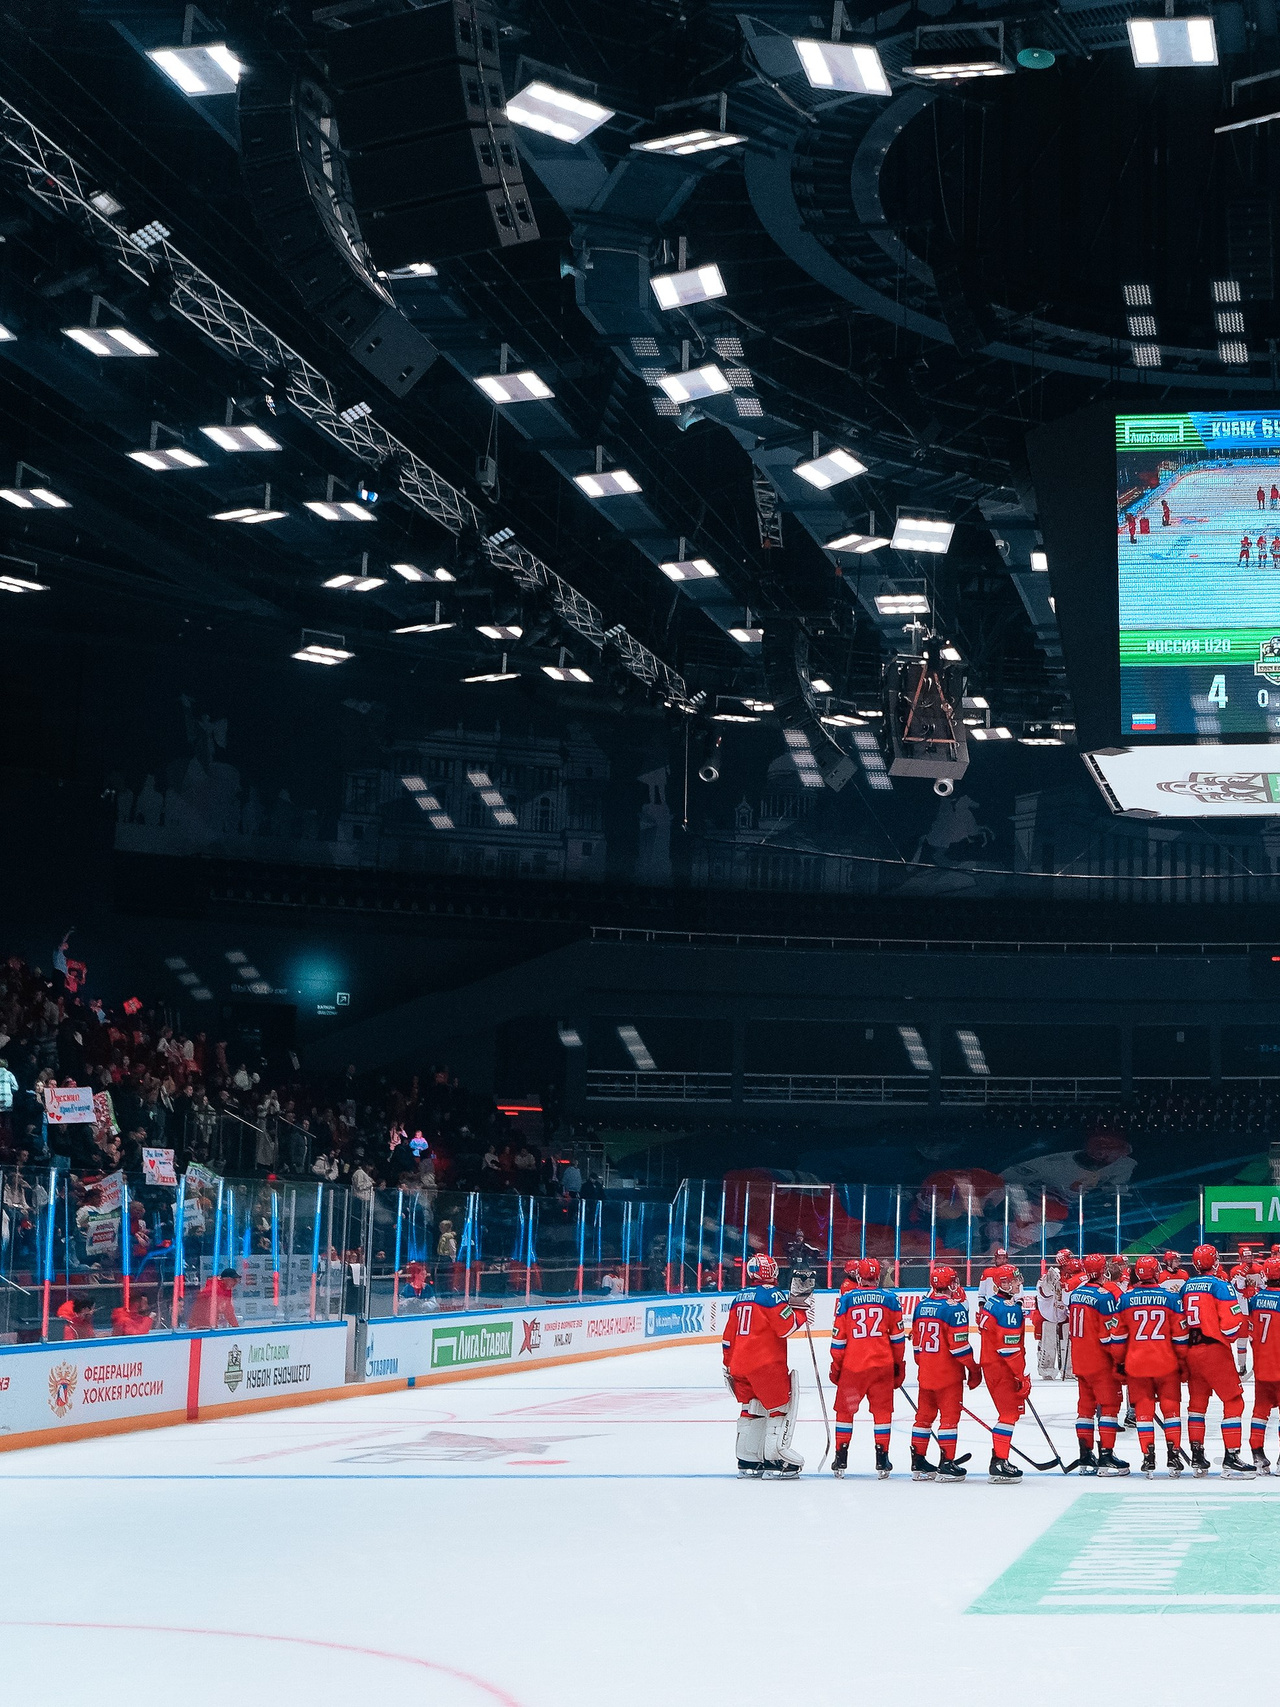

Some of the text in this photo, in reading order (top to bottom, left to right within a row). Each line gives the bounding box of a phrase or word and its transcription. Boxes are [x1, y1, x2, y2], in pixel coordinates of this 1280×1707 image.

[1146, 638, 1231, 654] РОССИЯ U20
[1207, 674, 1229, 709] 4
[852, 1295, 885, 1305] KHVOROV
[1129, 1295, 1167, 1306] SOLOVYOV
[1186, 1295, 1200, 1327] 5
[1256, 1298, 1278, 1310] KHANIN
[851, 1307, 884, 1339] 32
[954, 1310, 968, 1325] 23
[1006, 1312, 1017, 1326] 14
[1072, 1307, 1085, 1338] 11
[1133, 1309, 1165, 1341] 22
[1259, 1313, 1272, 1344] 7
[247, 1343, 291, 1364] Лига Ставок
[458, 1328, 512, 1361] Лига Ставок
[84, 1361, 143, 1384] ФЕДЕРАЦИЯ
[246, 1364, 311, 1389] КУБОК БУДУЩЕГО
[82, 1380, 164, 1404] ХОККЕЯ РОССИИ
